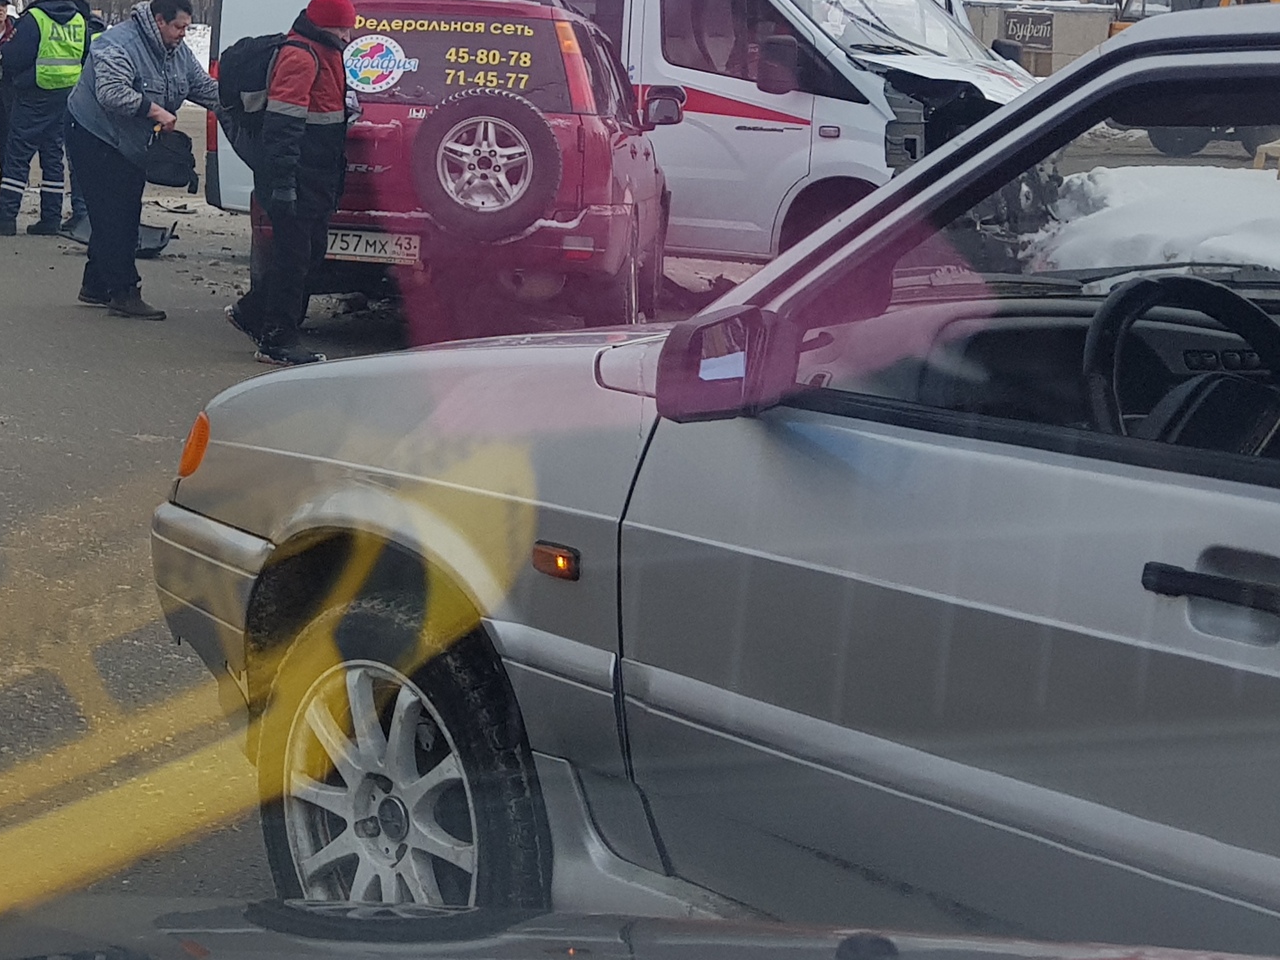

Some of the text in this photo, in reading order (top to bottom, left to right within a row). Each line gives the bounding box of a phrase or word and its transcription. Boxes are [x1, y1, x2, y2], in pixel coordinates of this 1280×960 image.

[489, 23, 534, 36] сеть
[1006, 17, 1051, 41] Буфет
[345, 55, 418, 74] ография
[445, 47, 532, 67] 45-80-78
[445, 69, 529, 89] 71-45-77
[394, 236, 413, 251] 43
